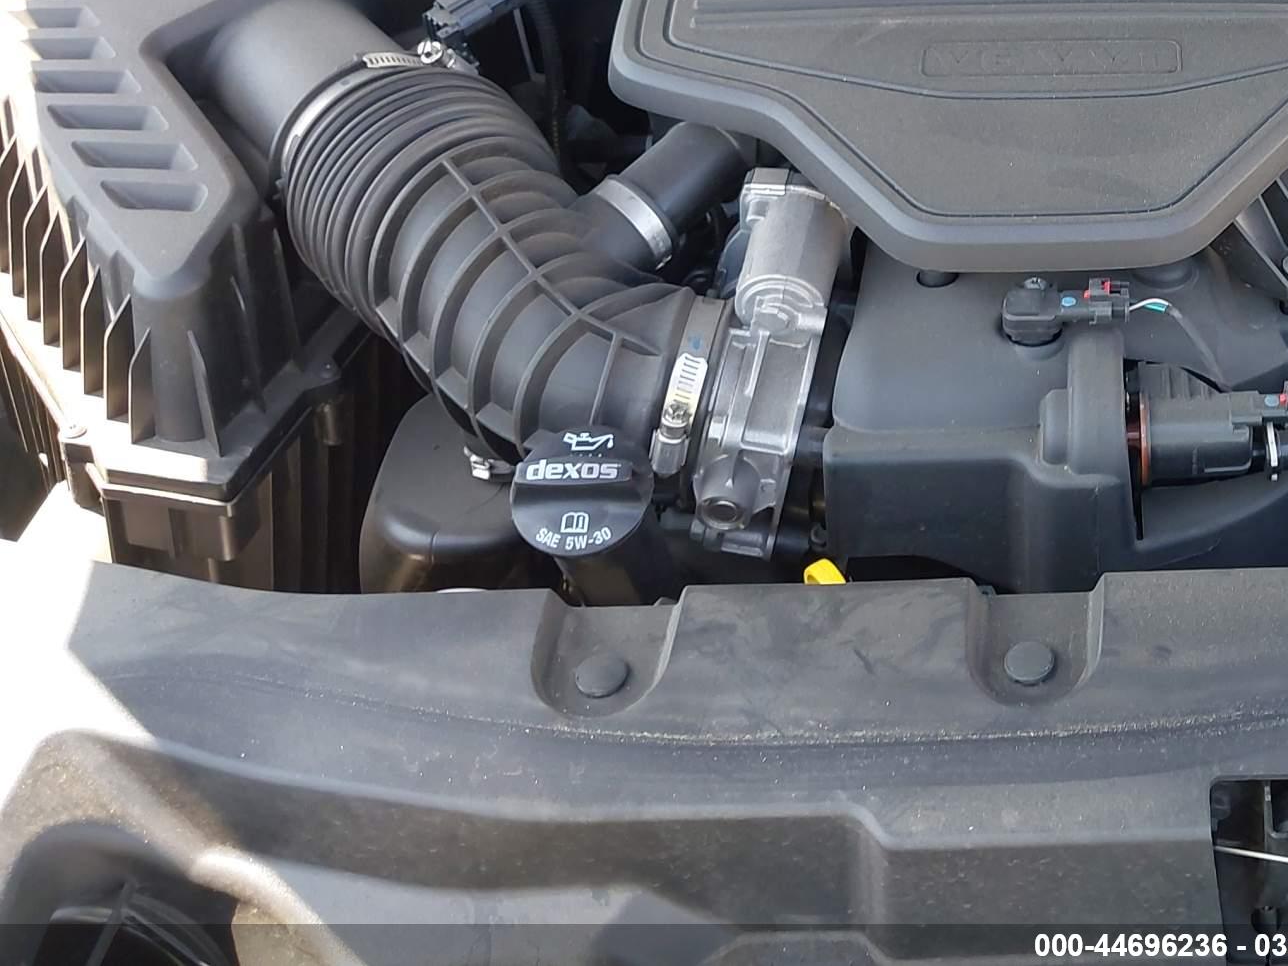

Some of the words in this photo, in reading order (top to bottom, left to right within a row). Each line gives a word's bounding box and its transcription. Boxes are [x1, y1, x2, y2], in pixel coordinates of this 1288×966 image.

[526, 459, 621, 480] dexos
[535, 527, 561, 549] SAE
[565, 526, 612, 550] 5W-30
